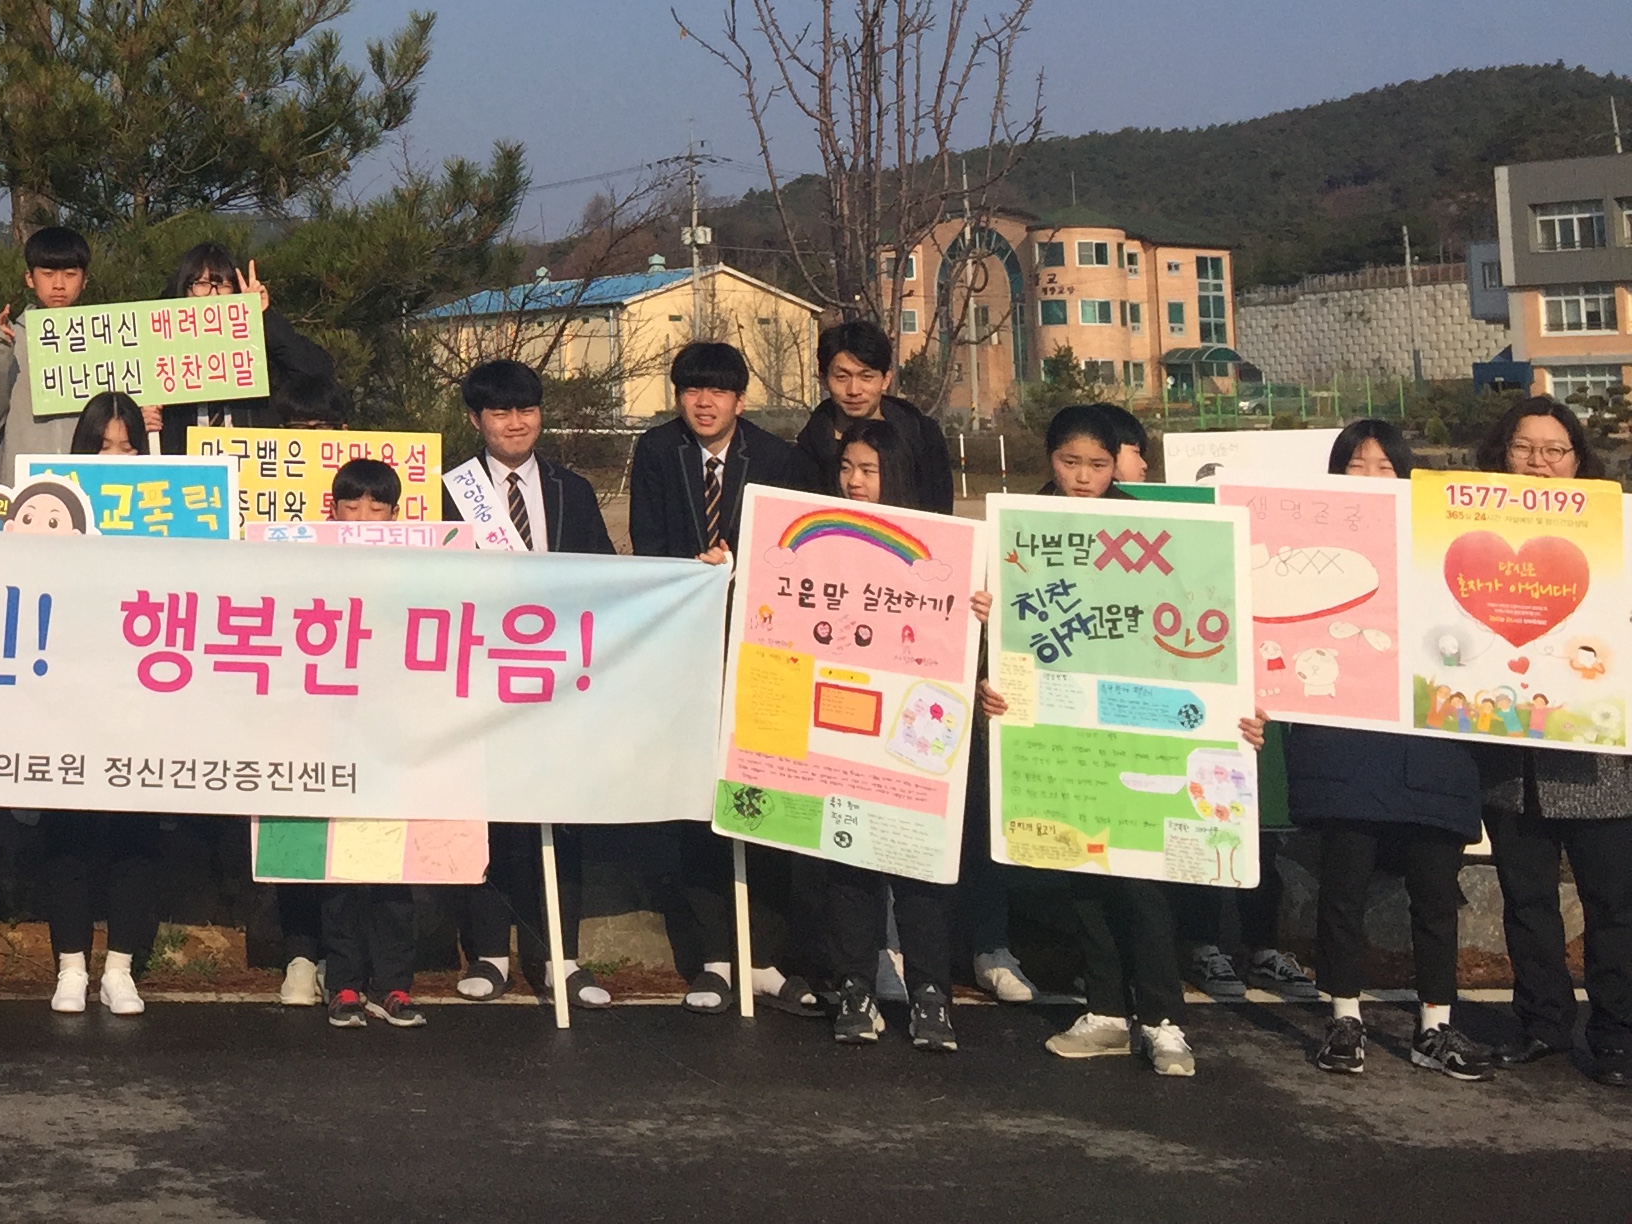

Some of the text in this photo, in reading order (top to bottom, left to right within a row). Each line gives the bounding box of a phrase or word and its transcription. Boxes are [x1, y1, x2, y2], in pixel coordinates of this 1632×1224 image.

[39, 303, 249, 353] 욕설대신 배려의말
[43, 350, 254, 399] 비난대신 칭찬의말
[44, 467, 221, 536] 교폭력
[1446, 484, 1586, 514] 1577-0199
[1015, 531, 1096, 567] 나쁜말
[1498, 561, 1537, 577] 당신은
[776, 576, 956, 621] 고운말 실천하기!
[1010, 578, 1083, 622] 칭찬
[1457, 573, 1504, 598] 혼자가
[1029, 612, 1097, 664] 하자
[1087, 604, 1145, 640] 고운말
[120, 589, 373, 696] 행복한
[404, 601, 595, 705] 마음!
[103, 756, 359, 795] 정신건강증진센터
